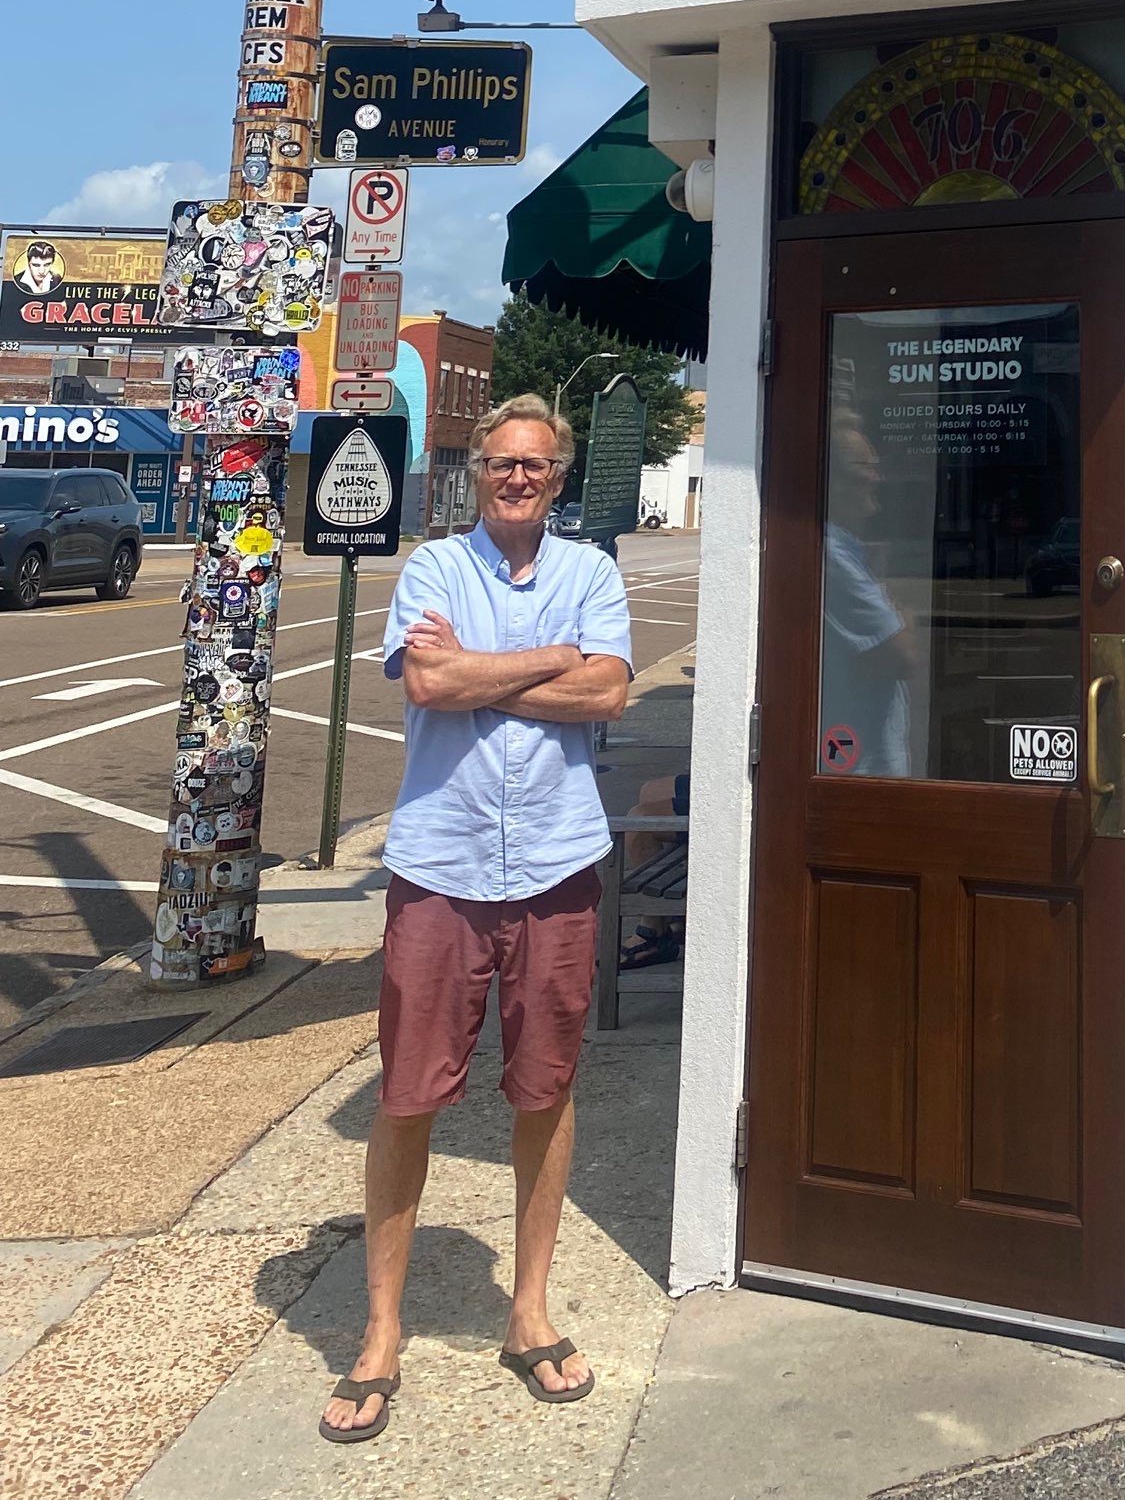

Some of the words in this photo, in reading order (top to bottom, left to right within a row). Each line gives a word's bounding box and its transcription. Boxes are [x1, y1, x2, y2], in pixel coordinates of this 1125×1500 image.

[246, 7, 287, 29] REM
[243, 41, 284, 65] CFS
[332, 67, 397, 99] Sam
[412, 67, 518, 108] Phillips
[388, 119, 456, 138] AVENUE
[911, 98, 1027, 163] 706
[351, 231, 370, 245] Any
[375, 231, 397, 243] Time
[65, 286, 92, 299] LIVE
[96, 287, 119, 299] THE
[135, 288, 158, 301] LEG
[342, 278, 358, 297] NO
[360, 282, 397, 294] PARKING
[360, 303, 379, 316] BUS
[347, 317, 387, 330] LOADING
[340, 340, 394, 354] UNLOADING
[887, 341, 919, 356] THE
[923, 336, 1023, 355] LEGENDARY
[353, 354, 378, 368] ONLY
[888, 363, 933, 384] SUN
[939, 360, 1022, 382] STUDIO
[883, 406, 934, 417] GUIDED
[938, 404, 983, 416] TOURS
[987, 403, 1027, 415] DAILY
[880, 422, 916, 430] MONDAY
[976, 420, 1001, 428] 10:00
[882, 434, 914, 442] FRIDAY
[972, 432, 998, 440] 10:00
[948, 445, 973, 454] 10:00
[137, 469, 163, 478] ORDER
[336, 463, 378, 472] TENNESSEE
[136, 478, 162, 487] AHEAD
[333, 476, 378, 491] MUSIC
[328, 496, 381, 508] PATHWAYS
[317, 533, 349, 544] OFFICIAL
[350, 533, 386, 545] LOCATION
[1014, 729, 1050, 759] NO
[1013, 758, 1034, 768] PETS
[1035, 759, 1074, 770] ALLOWED
[1032, 769, 1051, 777] SERVICE
